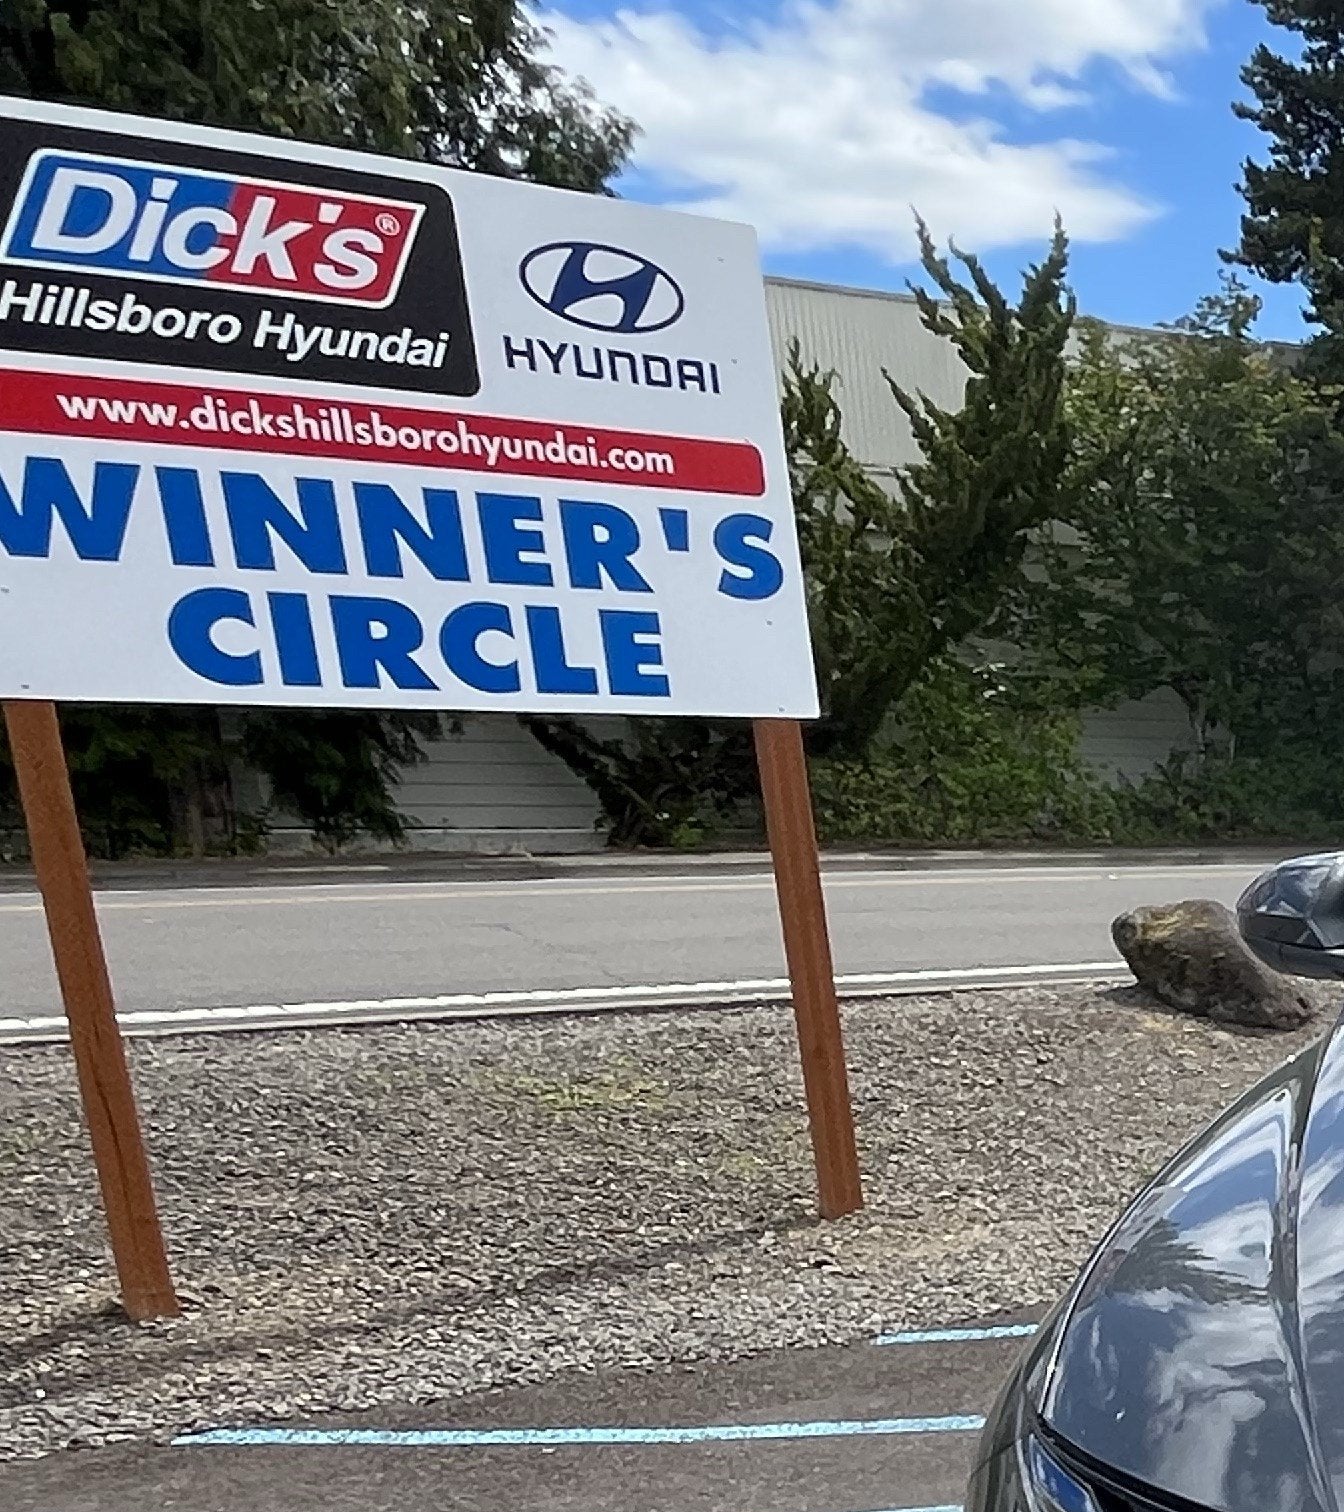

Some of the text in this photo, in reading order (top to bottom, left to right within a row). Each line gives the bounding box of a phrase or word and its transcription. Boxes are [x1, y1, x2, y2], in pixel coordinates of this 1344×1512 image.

[0, 280, 450, 368] Hillsboro Hyundai
[503, 335, 721, 395] HYUNDAI
[56, 393, 674, 475] www.dickshillsborohyundai.com
[0, 455, 785, 601] WINNER'S
[167, 587, 671, 698] CIRCLE
